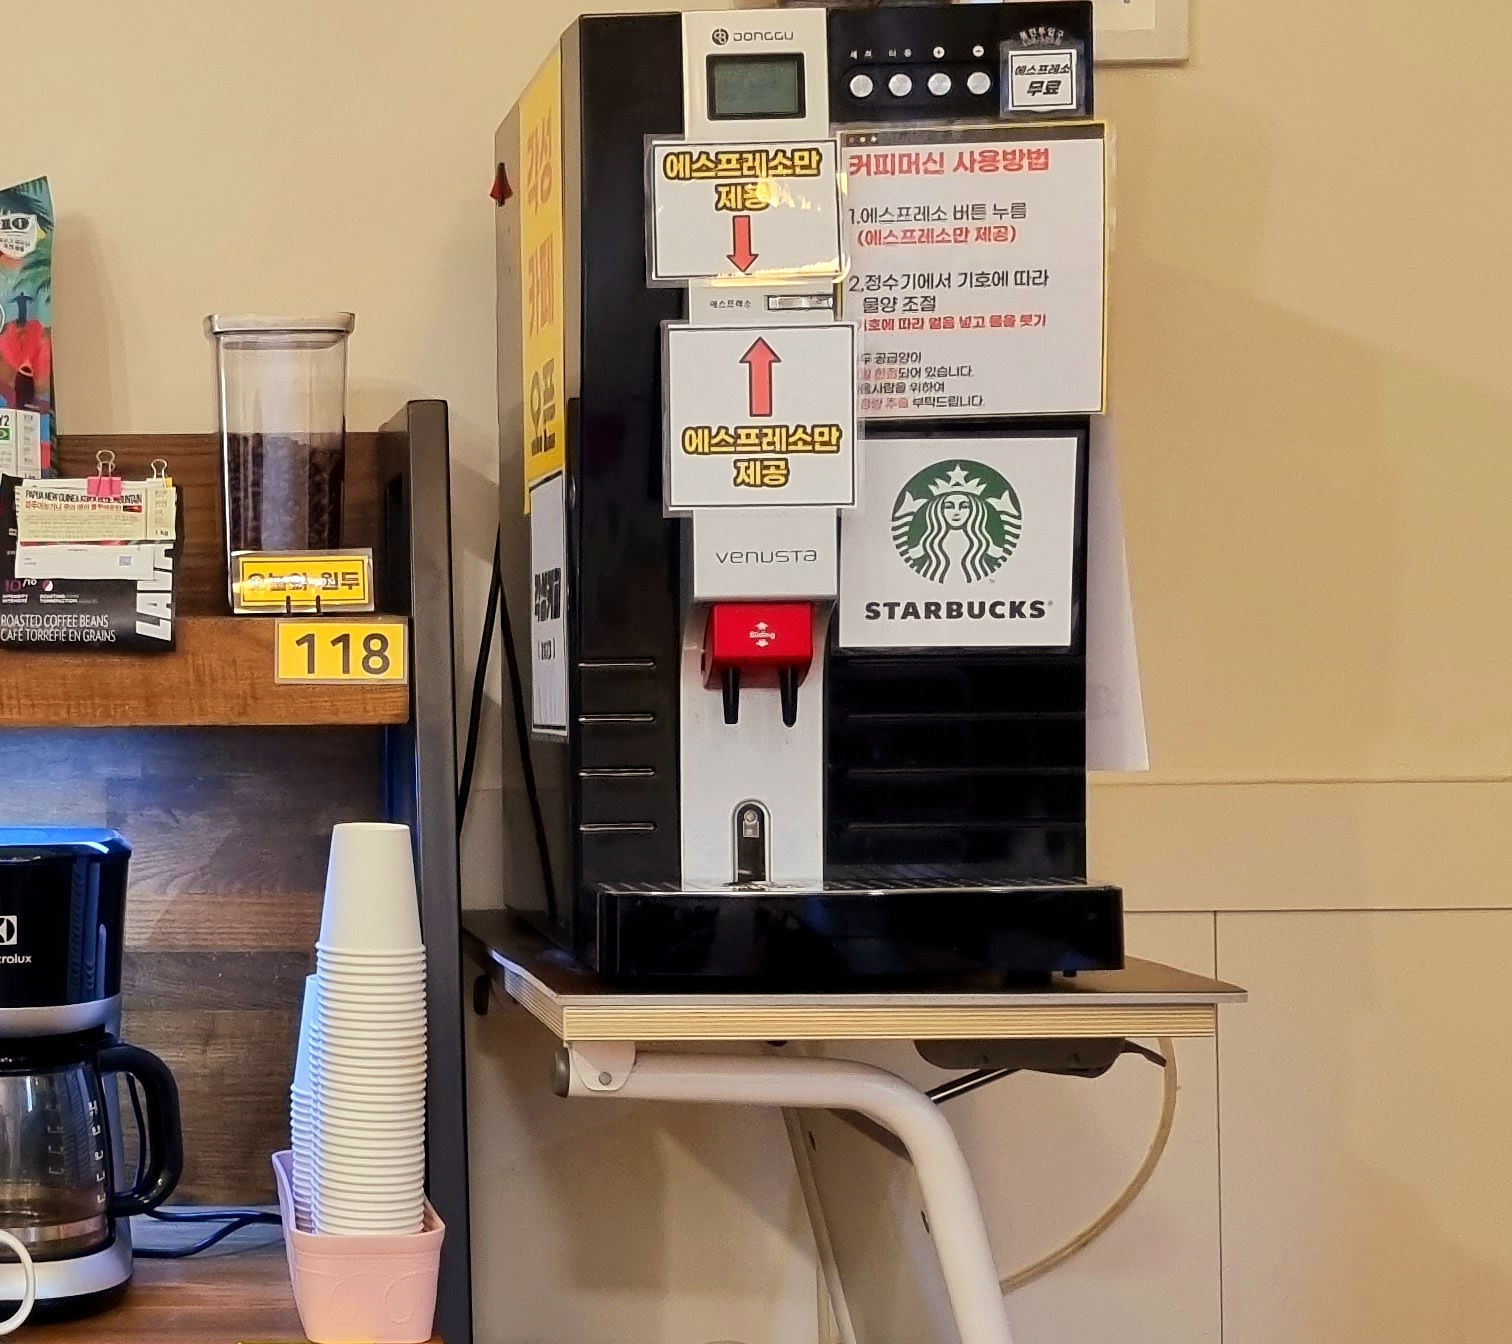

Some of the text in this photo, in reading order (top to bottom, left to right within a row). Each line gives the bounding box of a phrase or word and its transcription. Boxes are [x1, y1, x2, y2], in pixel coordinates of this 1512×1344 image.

[1014, 63, 1070, 76] 에스프레소
[1027, 80, 1061, 96] 무료
[663, 148, 824, 180] 에스프레소만
[849, 147, 1050, 178] 커피머신 사용방법
[0, 217, 30, 230] 10
[849, 201, 1027, 226] 1.에스프레소 버튼 누름
[857, 224, 1018, 247] (에스프레소만 제공)
[849, 268, 1050, 294] 2.정수기에서 기호에 따라
[862, 295, 937, 315] 물양 조절
[874, 351, 922, 365] 공급양이
[924, 365, 974, 379] 있습니다.
[909, 381, 945, 394] 위하여
[912, 395, 985, 410] 부탁드립니다.
[682, 424, 843, 455] 에스프레소만
[734, 457, 791, 488] 제공
[320, 571, 361, 591] 원두
[865, 600, 1046, 620] STARBUCKS
[1, 614, 109, 629] ROASTED COFFEE BEANS
[68, 630, 81, 642] EN
[82, 629, 117, 643] GRAINS
[295, 632, 390, 675] 118
